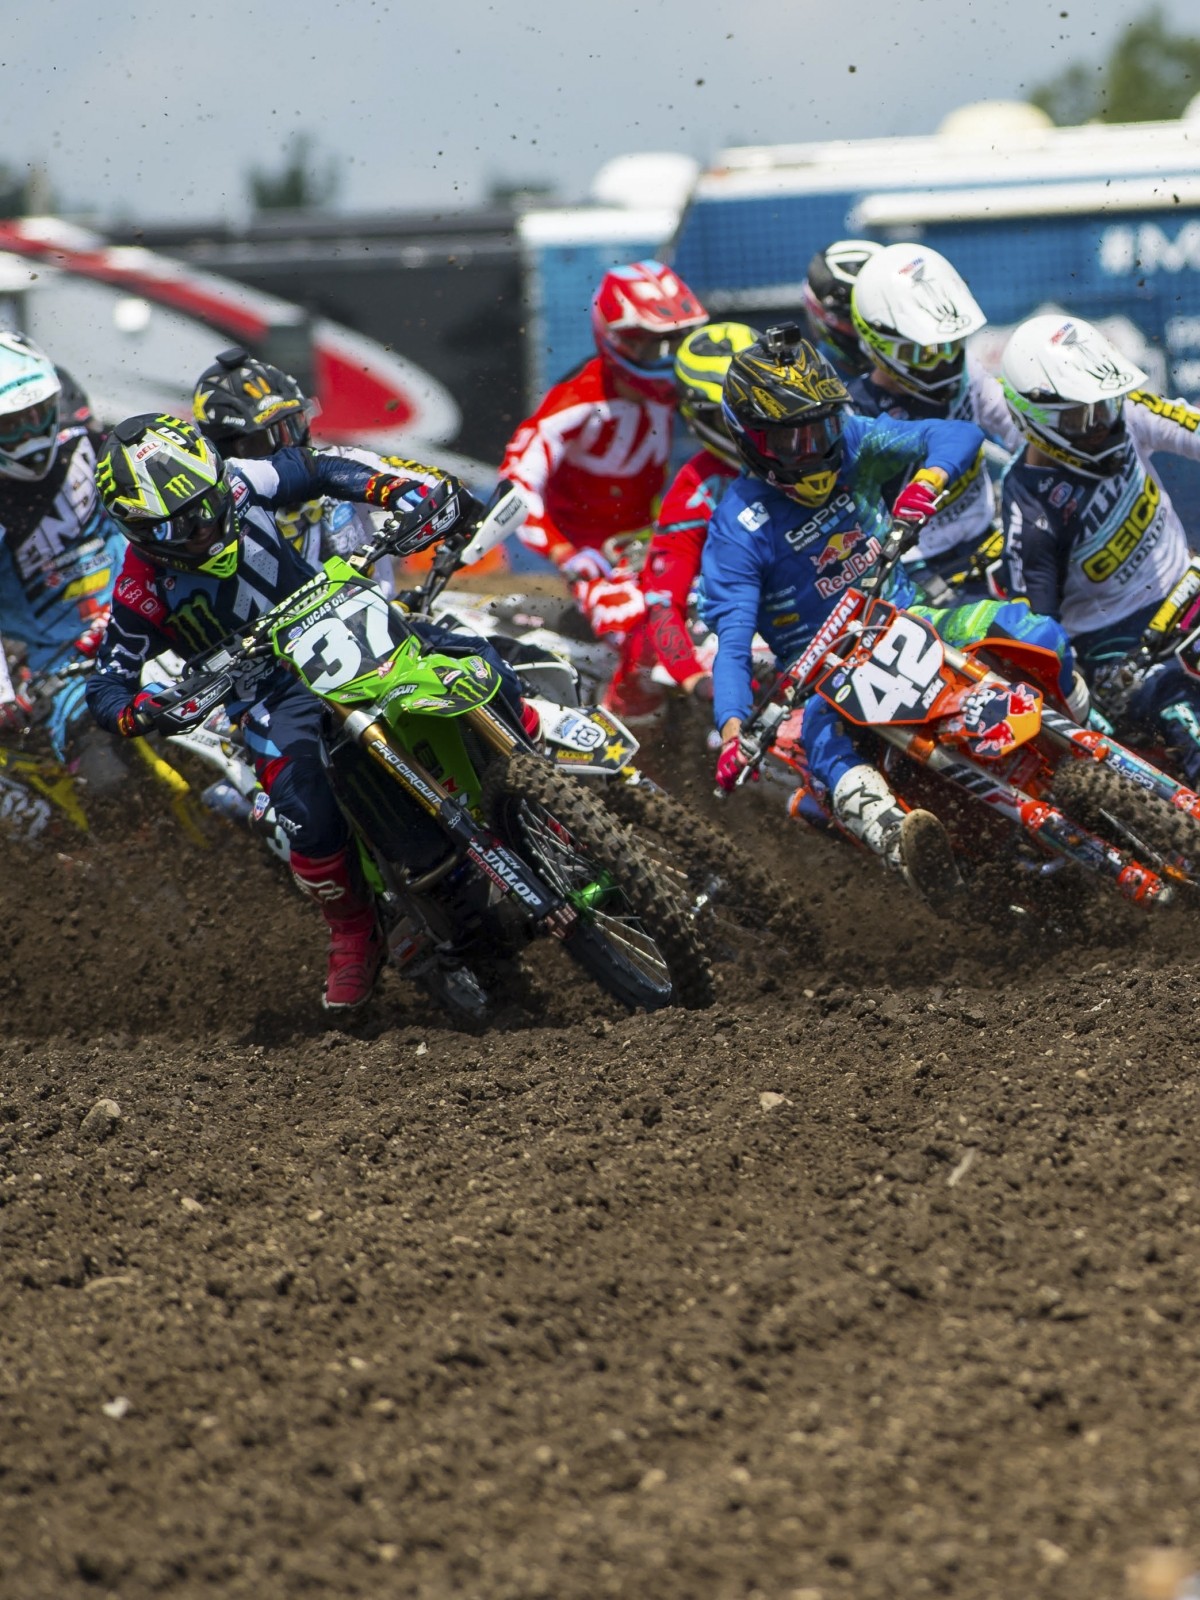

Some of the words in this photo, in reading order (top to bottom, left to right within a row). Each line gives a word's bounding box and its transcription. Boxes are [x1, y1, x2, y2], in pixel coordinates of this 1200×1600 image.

[136, 442, 160, 461] BELL
[209, 543, 223, 555] BELL
[785, 493, 851, 544] GoPro
[1081, 474, 1161, 584] GEICO
[1115, 507, 1168, 586] HONDA
[815, 560, 857, 599] Red
[849, 536, 882, 575] Bull
[293, 585, 395, 695] 37
[301, 602, 332, 631] LUCAS
[332, 592, 349, 610] OIL
[797, 593, 862, 680] RENTHAL
[851, 616, 944, 724] 42
[371, 741, 402, 766] PRO
[399, 761, 444, 805] CIRCUIT
[278, 813, 303, 836] FOX
[467, 847, 510, 892] BRAKING
[470, 841, 543, 906] DUNLOP
